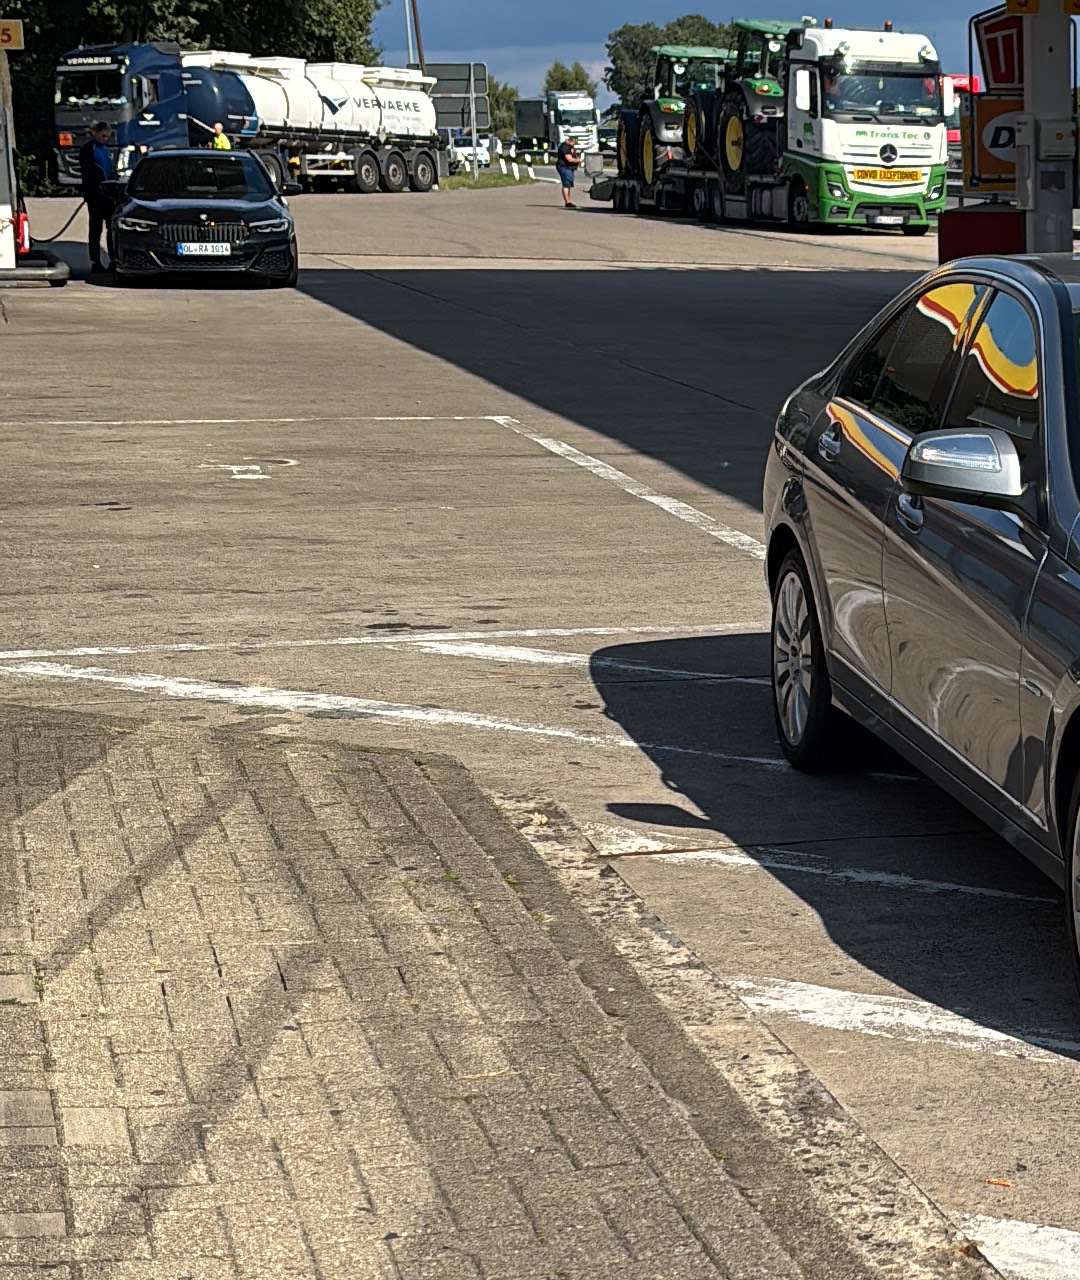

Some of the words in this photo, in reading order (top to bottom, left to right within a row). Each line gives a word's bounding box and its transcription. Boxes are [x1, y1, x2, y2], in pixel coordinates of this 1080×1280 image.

[0, 28, 12, 43] 5
[353, 97, 421, 112] VERVAEKE
[857, 170, 877, 179] CONVOI
